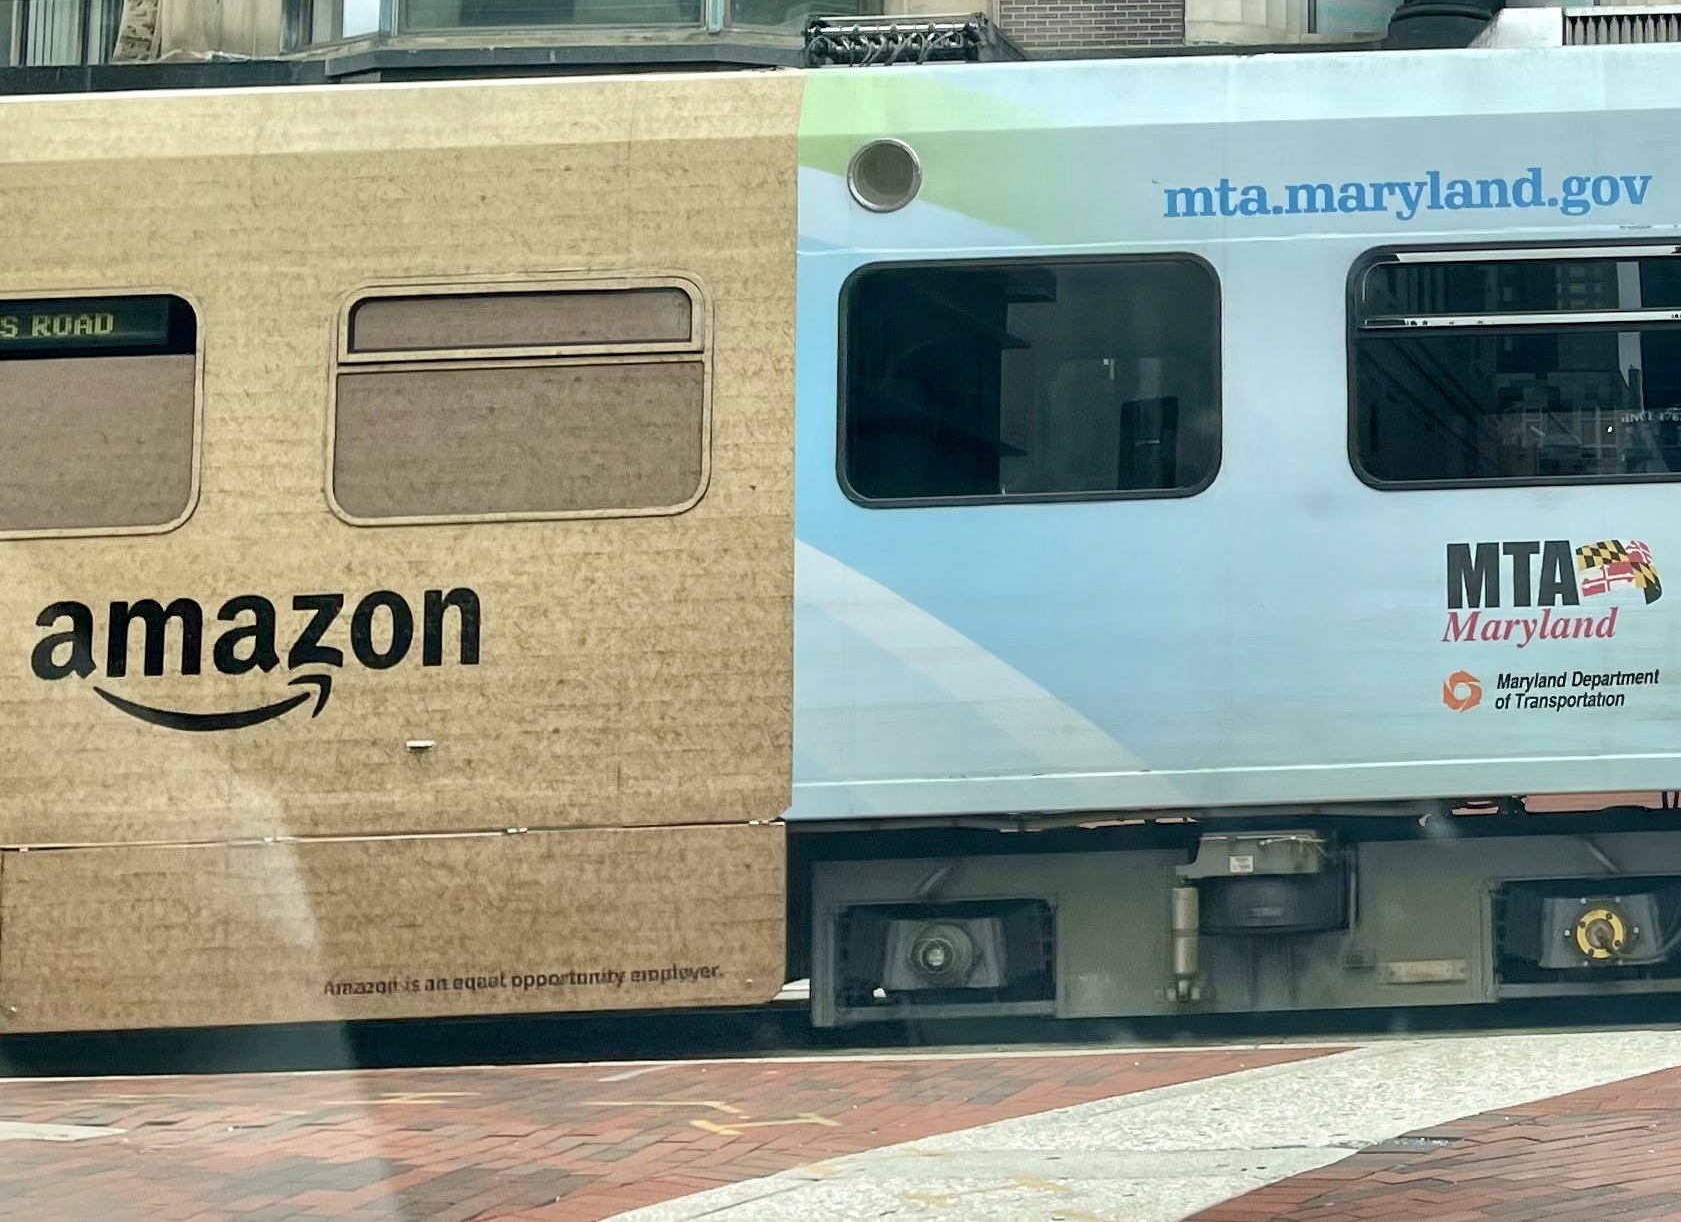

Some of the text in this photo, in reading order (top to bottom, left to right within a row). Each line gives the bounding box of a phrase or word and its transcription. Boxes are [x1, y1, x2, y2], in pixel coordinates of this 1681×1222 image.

[1163, 167, 1653, 221] mta.maryland.gov
[31, 313, 114, 338] ROAD
[1446, 540, 1580, 609] MTA
[31, 586, 481, 679] amazon
[1442, 606, 1619, 649] Maryland
[1496, 669, 1660, 692] Maryland Department
[1495, 689, 1625, 712] of Transportation
[324, 979, 399, 995] Amazon
[404, 976, 420, 992] is
[425, 978, 449, 992] an
[452, 972, 507, 993] equal
[511, 969, 626, 991] opportunity
